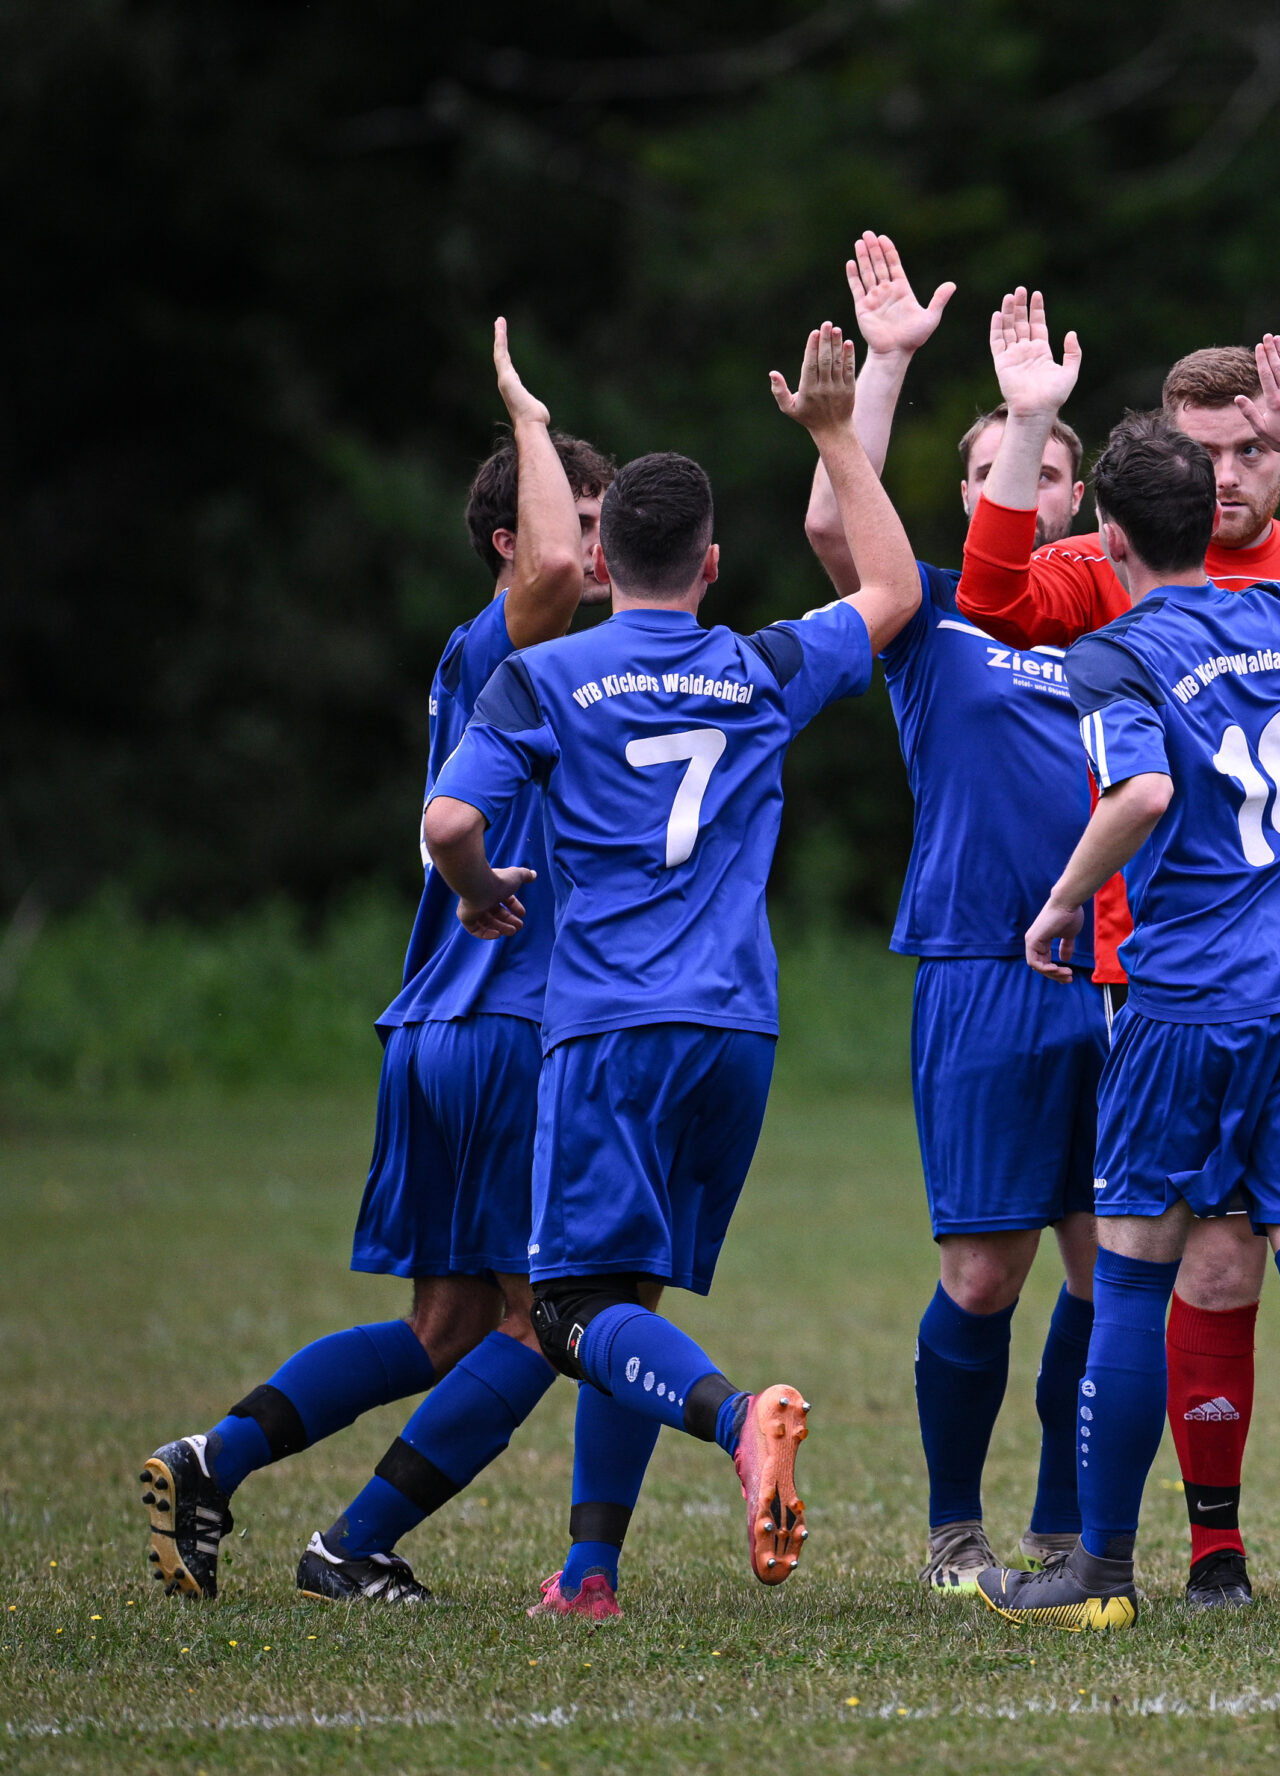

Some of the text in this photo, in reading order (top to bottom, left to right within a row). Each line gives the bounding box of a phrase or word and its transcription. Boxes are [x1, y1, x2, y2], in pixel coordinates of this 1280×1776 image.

[986, 647, 1068, 682] Ziefl
[572, 672, 754, 709] VfB Kickers Waldachtal
[1172, 675, 1200, 704] VfB
[625, 728, 727, 868] 7
[1183, 1410, 1240, 1422] adidas
